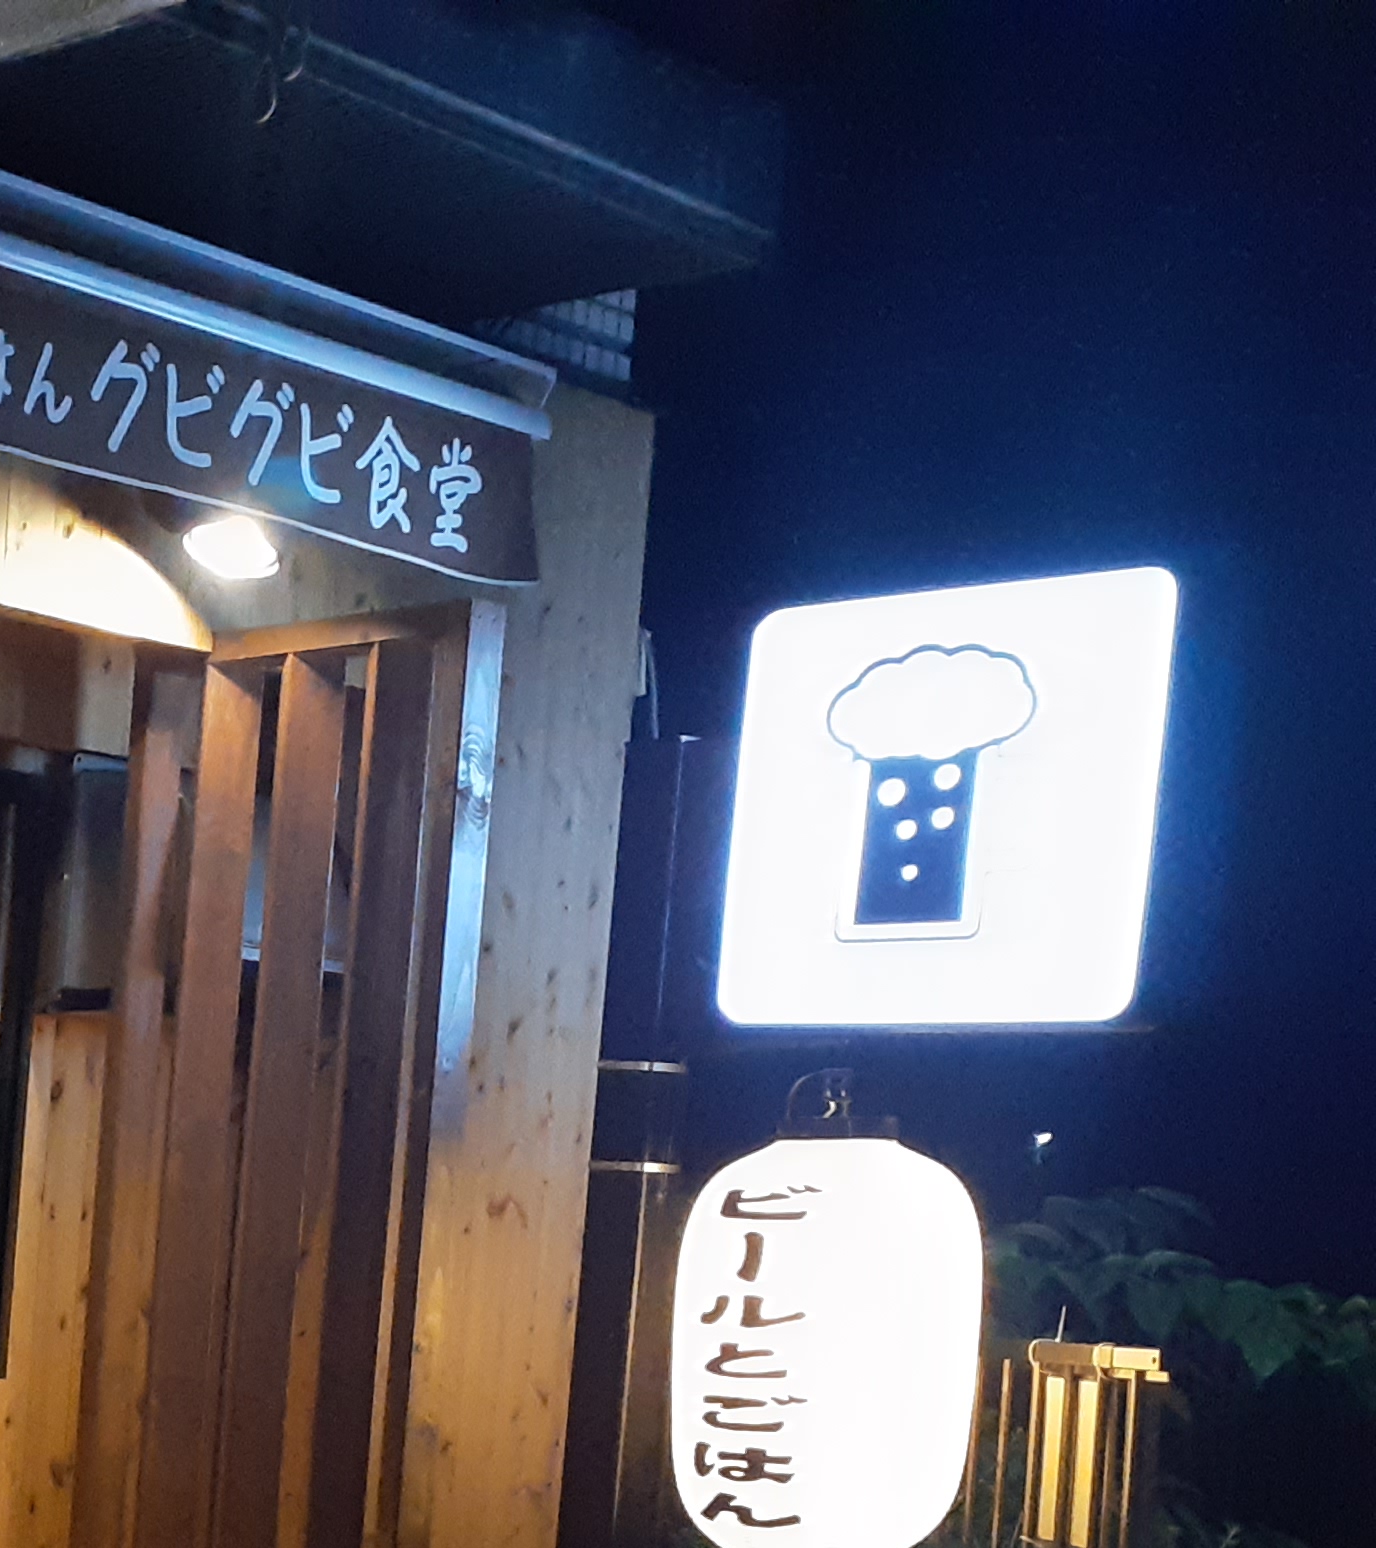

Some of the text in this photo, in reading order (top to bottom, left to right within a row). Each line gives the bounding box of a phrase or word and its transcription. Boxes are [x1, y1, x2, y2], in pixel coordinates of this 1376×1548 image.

[693, 1184, 823, 1529] ビールとごはん
